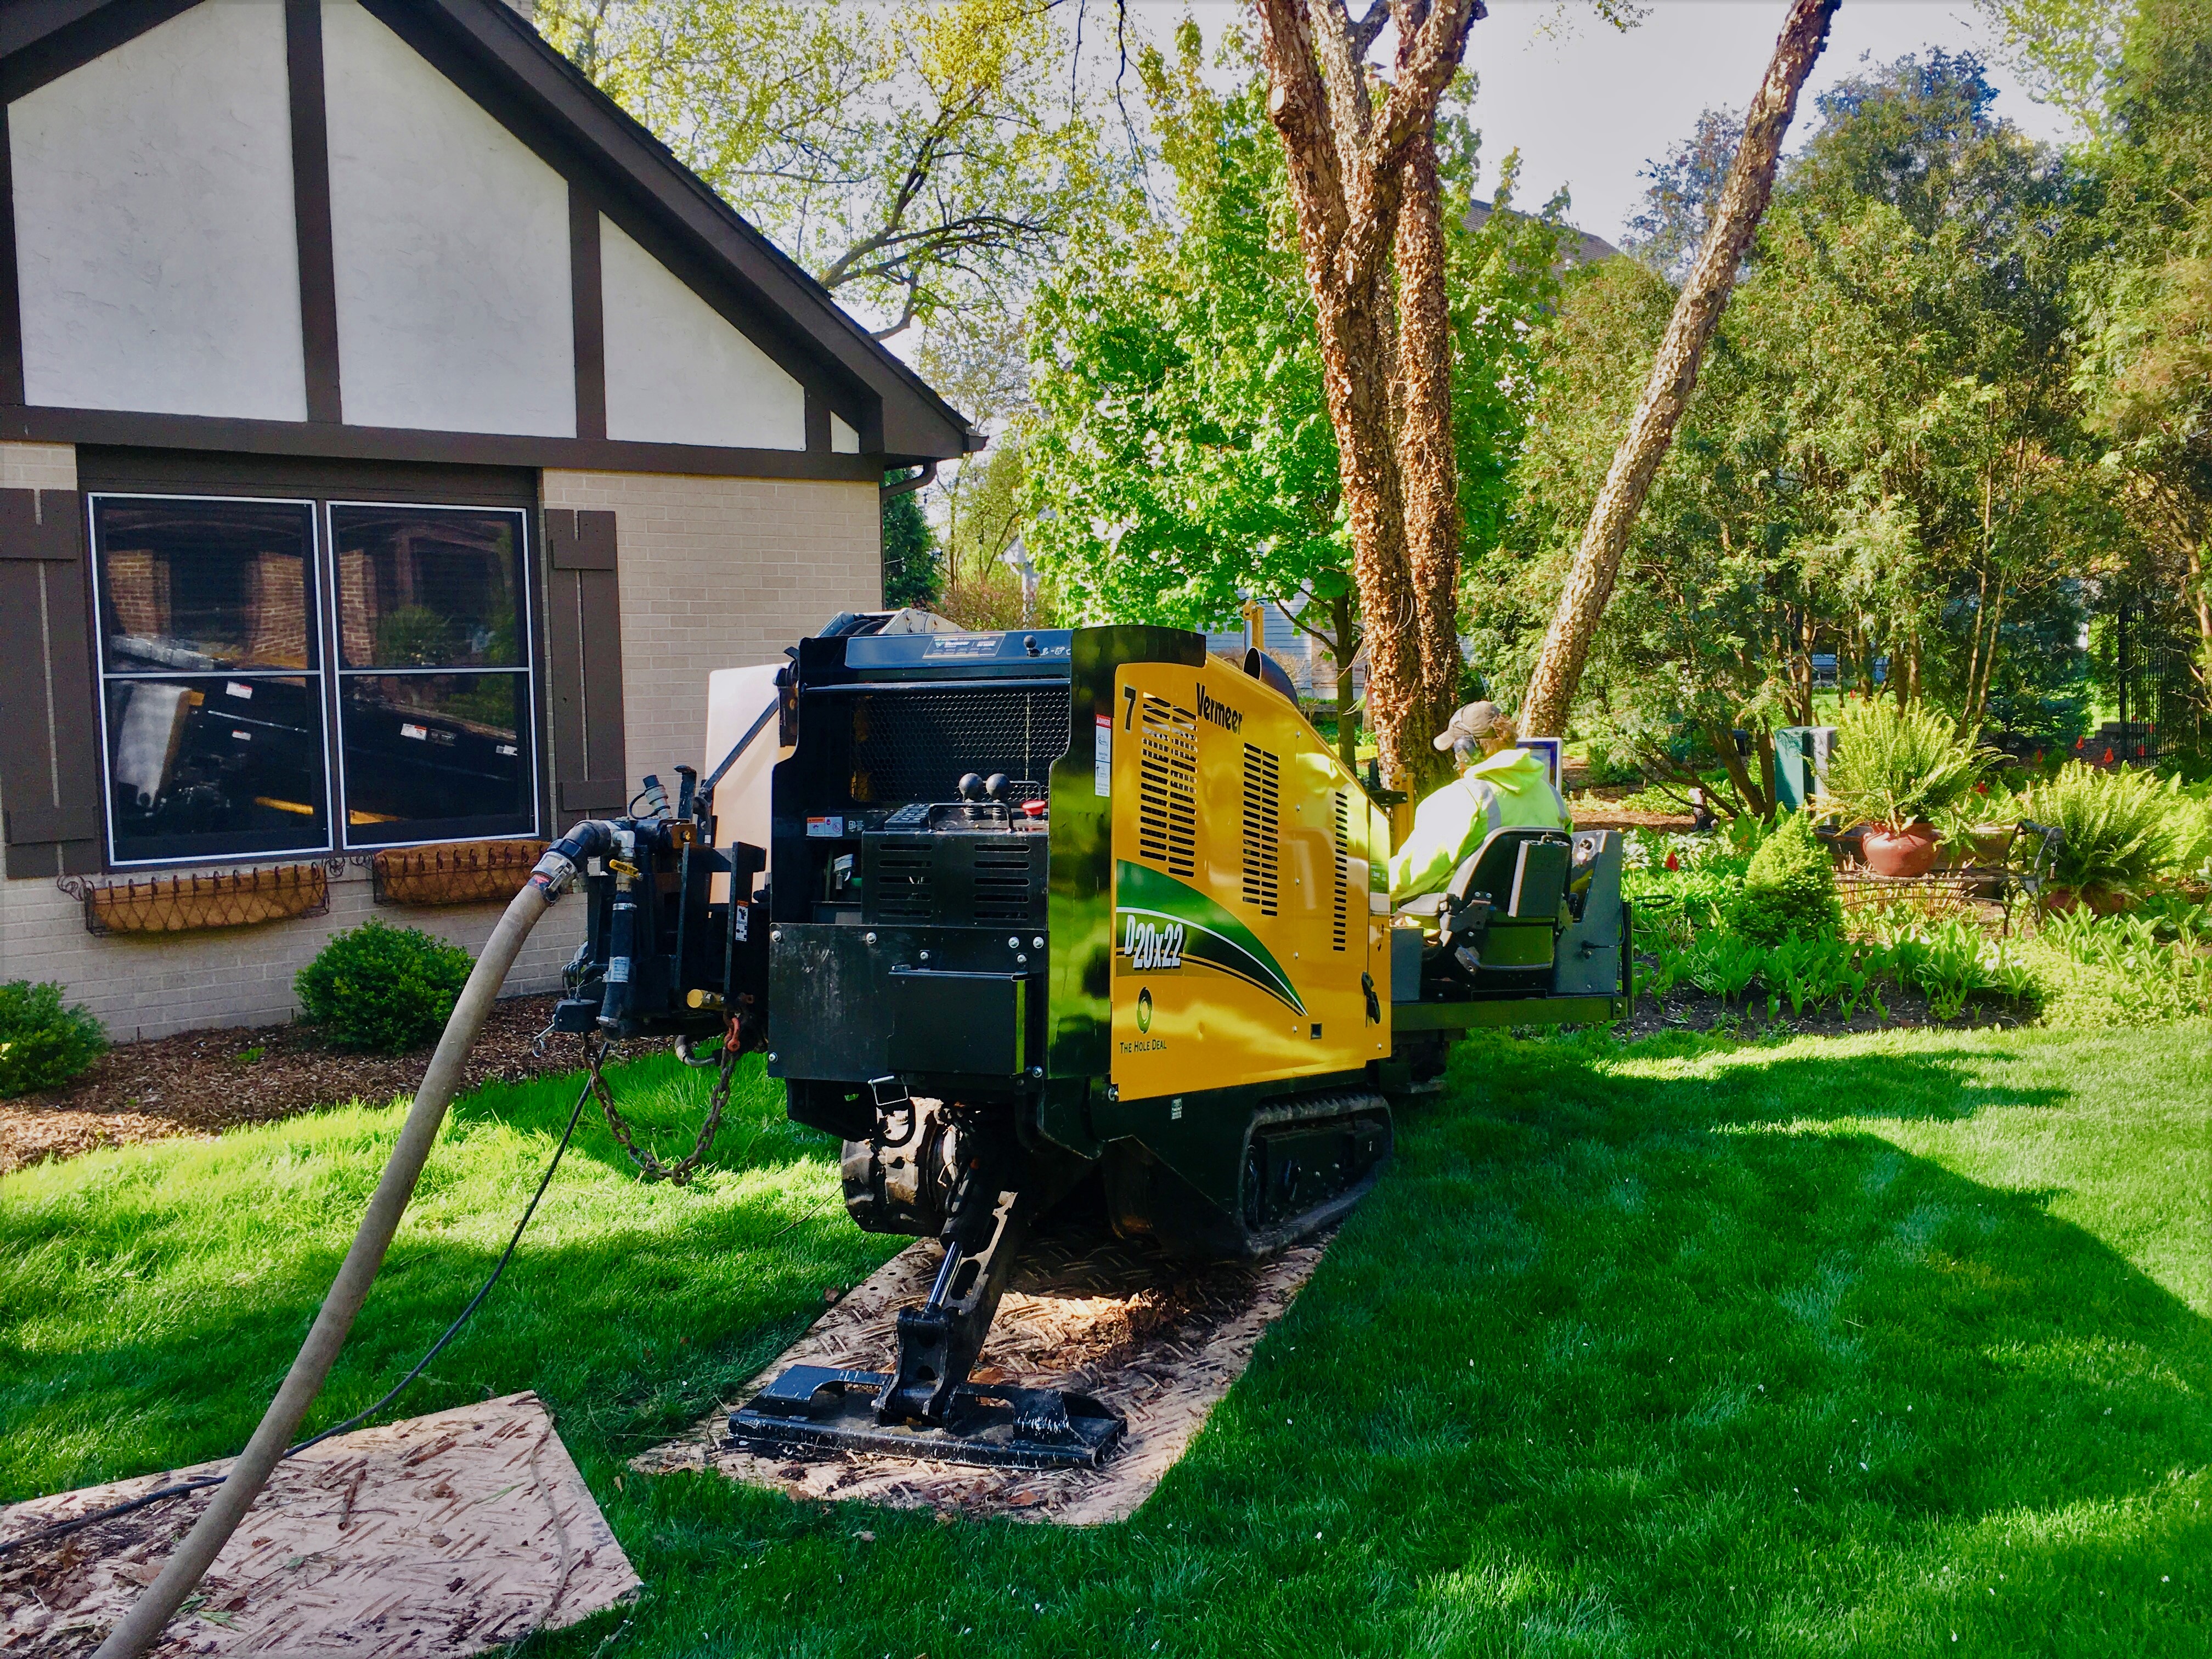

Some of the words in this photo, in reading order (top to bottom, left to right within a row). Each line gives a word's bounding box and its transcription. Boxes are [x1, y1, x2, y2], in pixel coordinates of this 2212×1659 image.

[1124, 685, 1137, 732] 7
[1196, 681, 1243, 736] Vermeer
[1124, 915, 1183, 969] D20x22
[1120, 1042, 1132, 1054] THE
[1134, 1040, 1150, 1052] HOLE
[1152, 1039, 1167, 1050] DEAL
